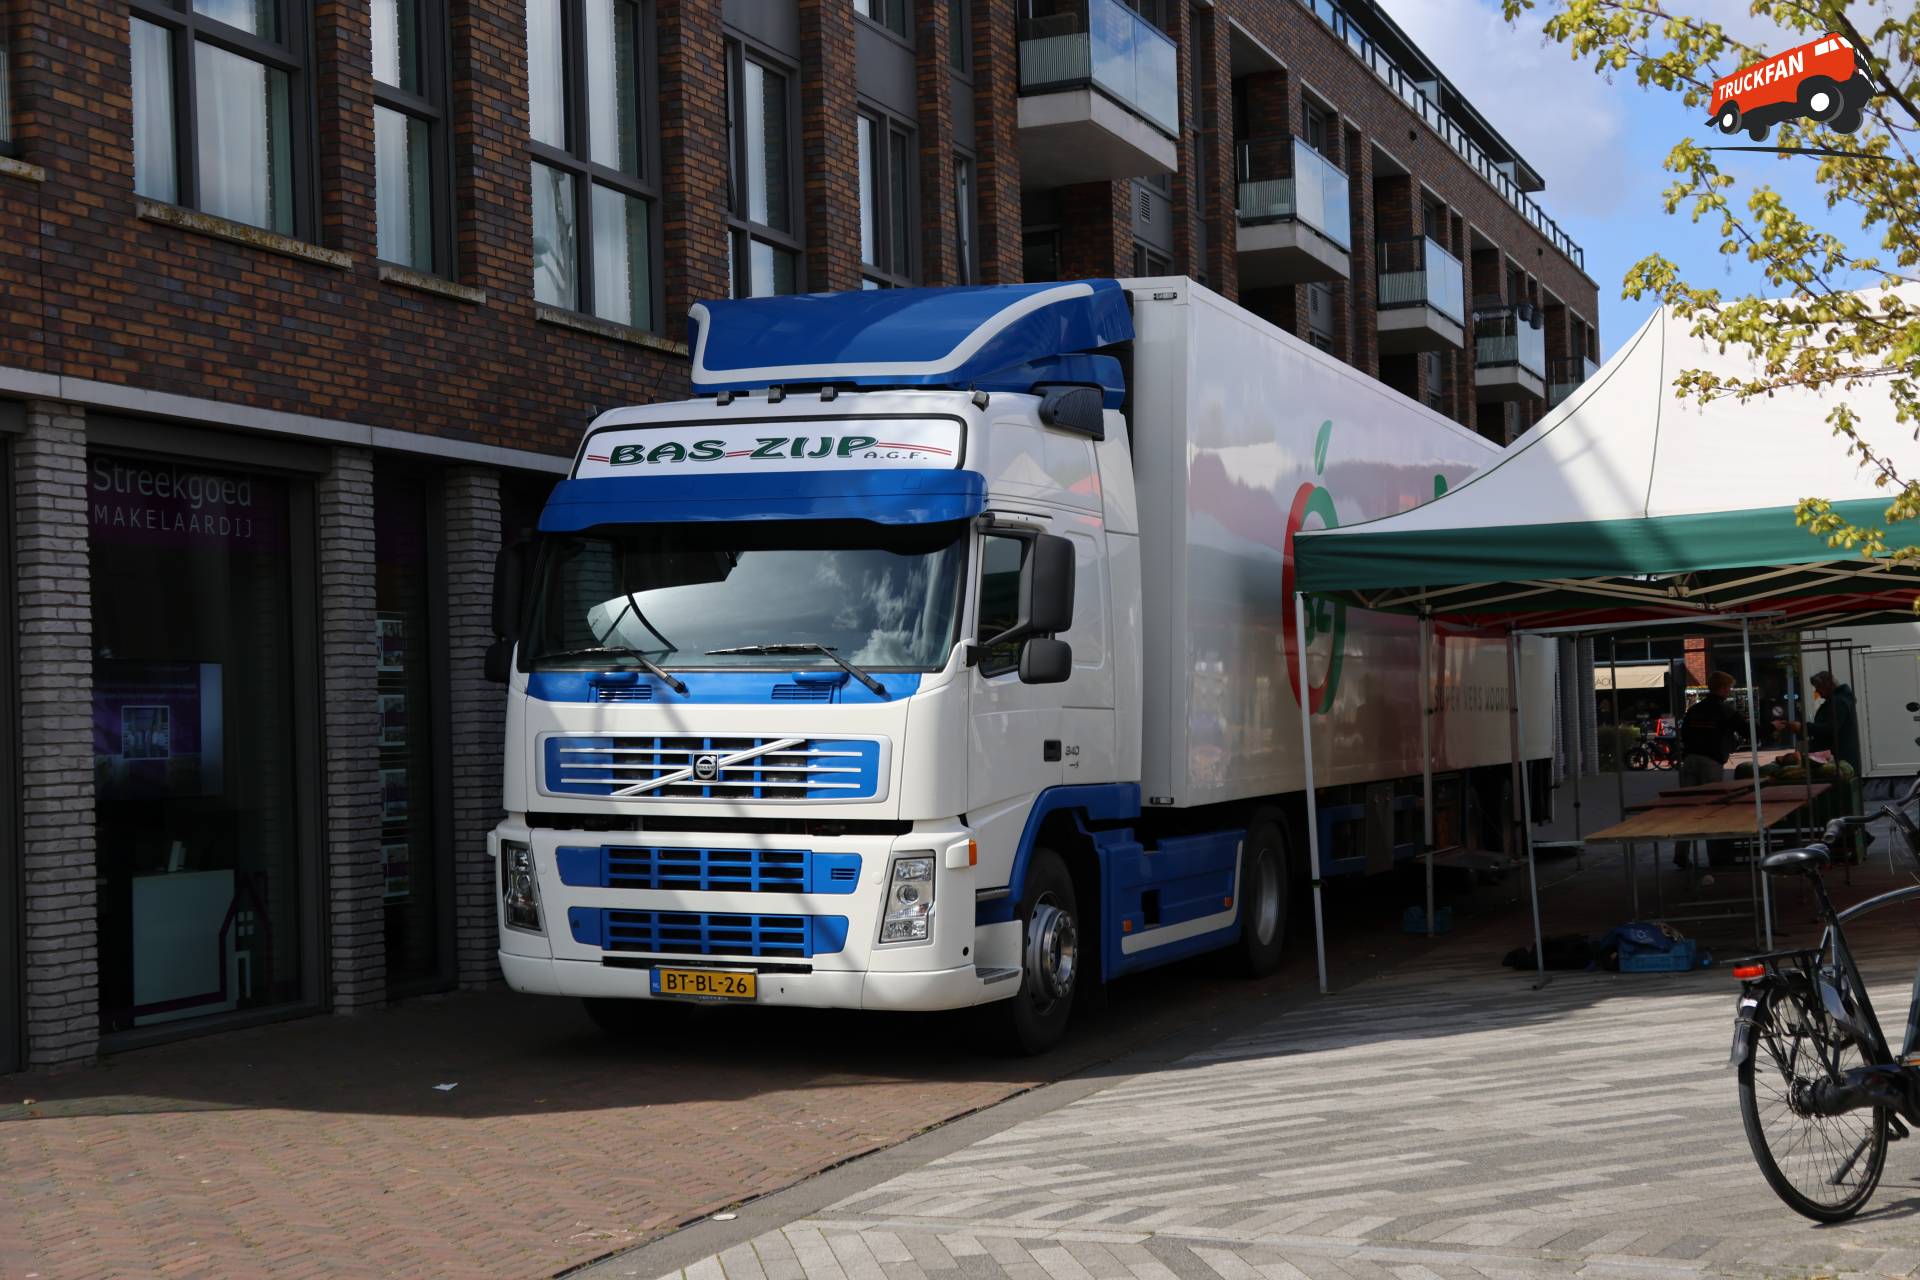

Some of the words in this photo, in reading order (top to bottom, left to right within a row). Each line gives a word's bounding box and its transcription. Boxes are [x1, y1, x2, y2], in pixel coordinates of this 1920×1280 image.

[609, 439, 726, 467] BAS
[750, 436, 879, 459] ZIJP
[863, 451, 928, 459] A.G.F.
[93, 457, 252, 509] Streekgoed
[94, 503, 252, 538] MAKELAARDIJ
[667, 973, 748, 993] BT-BL-26
